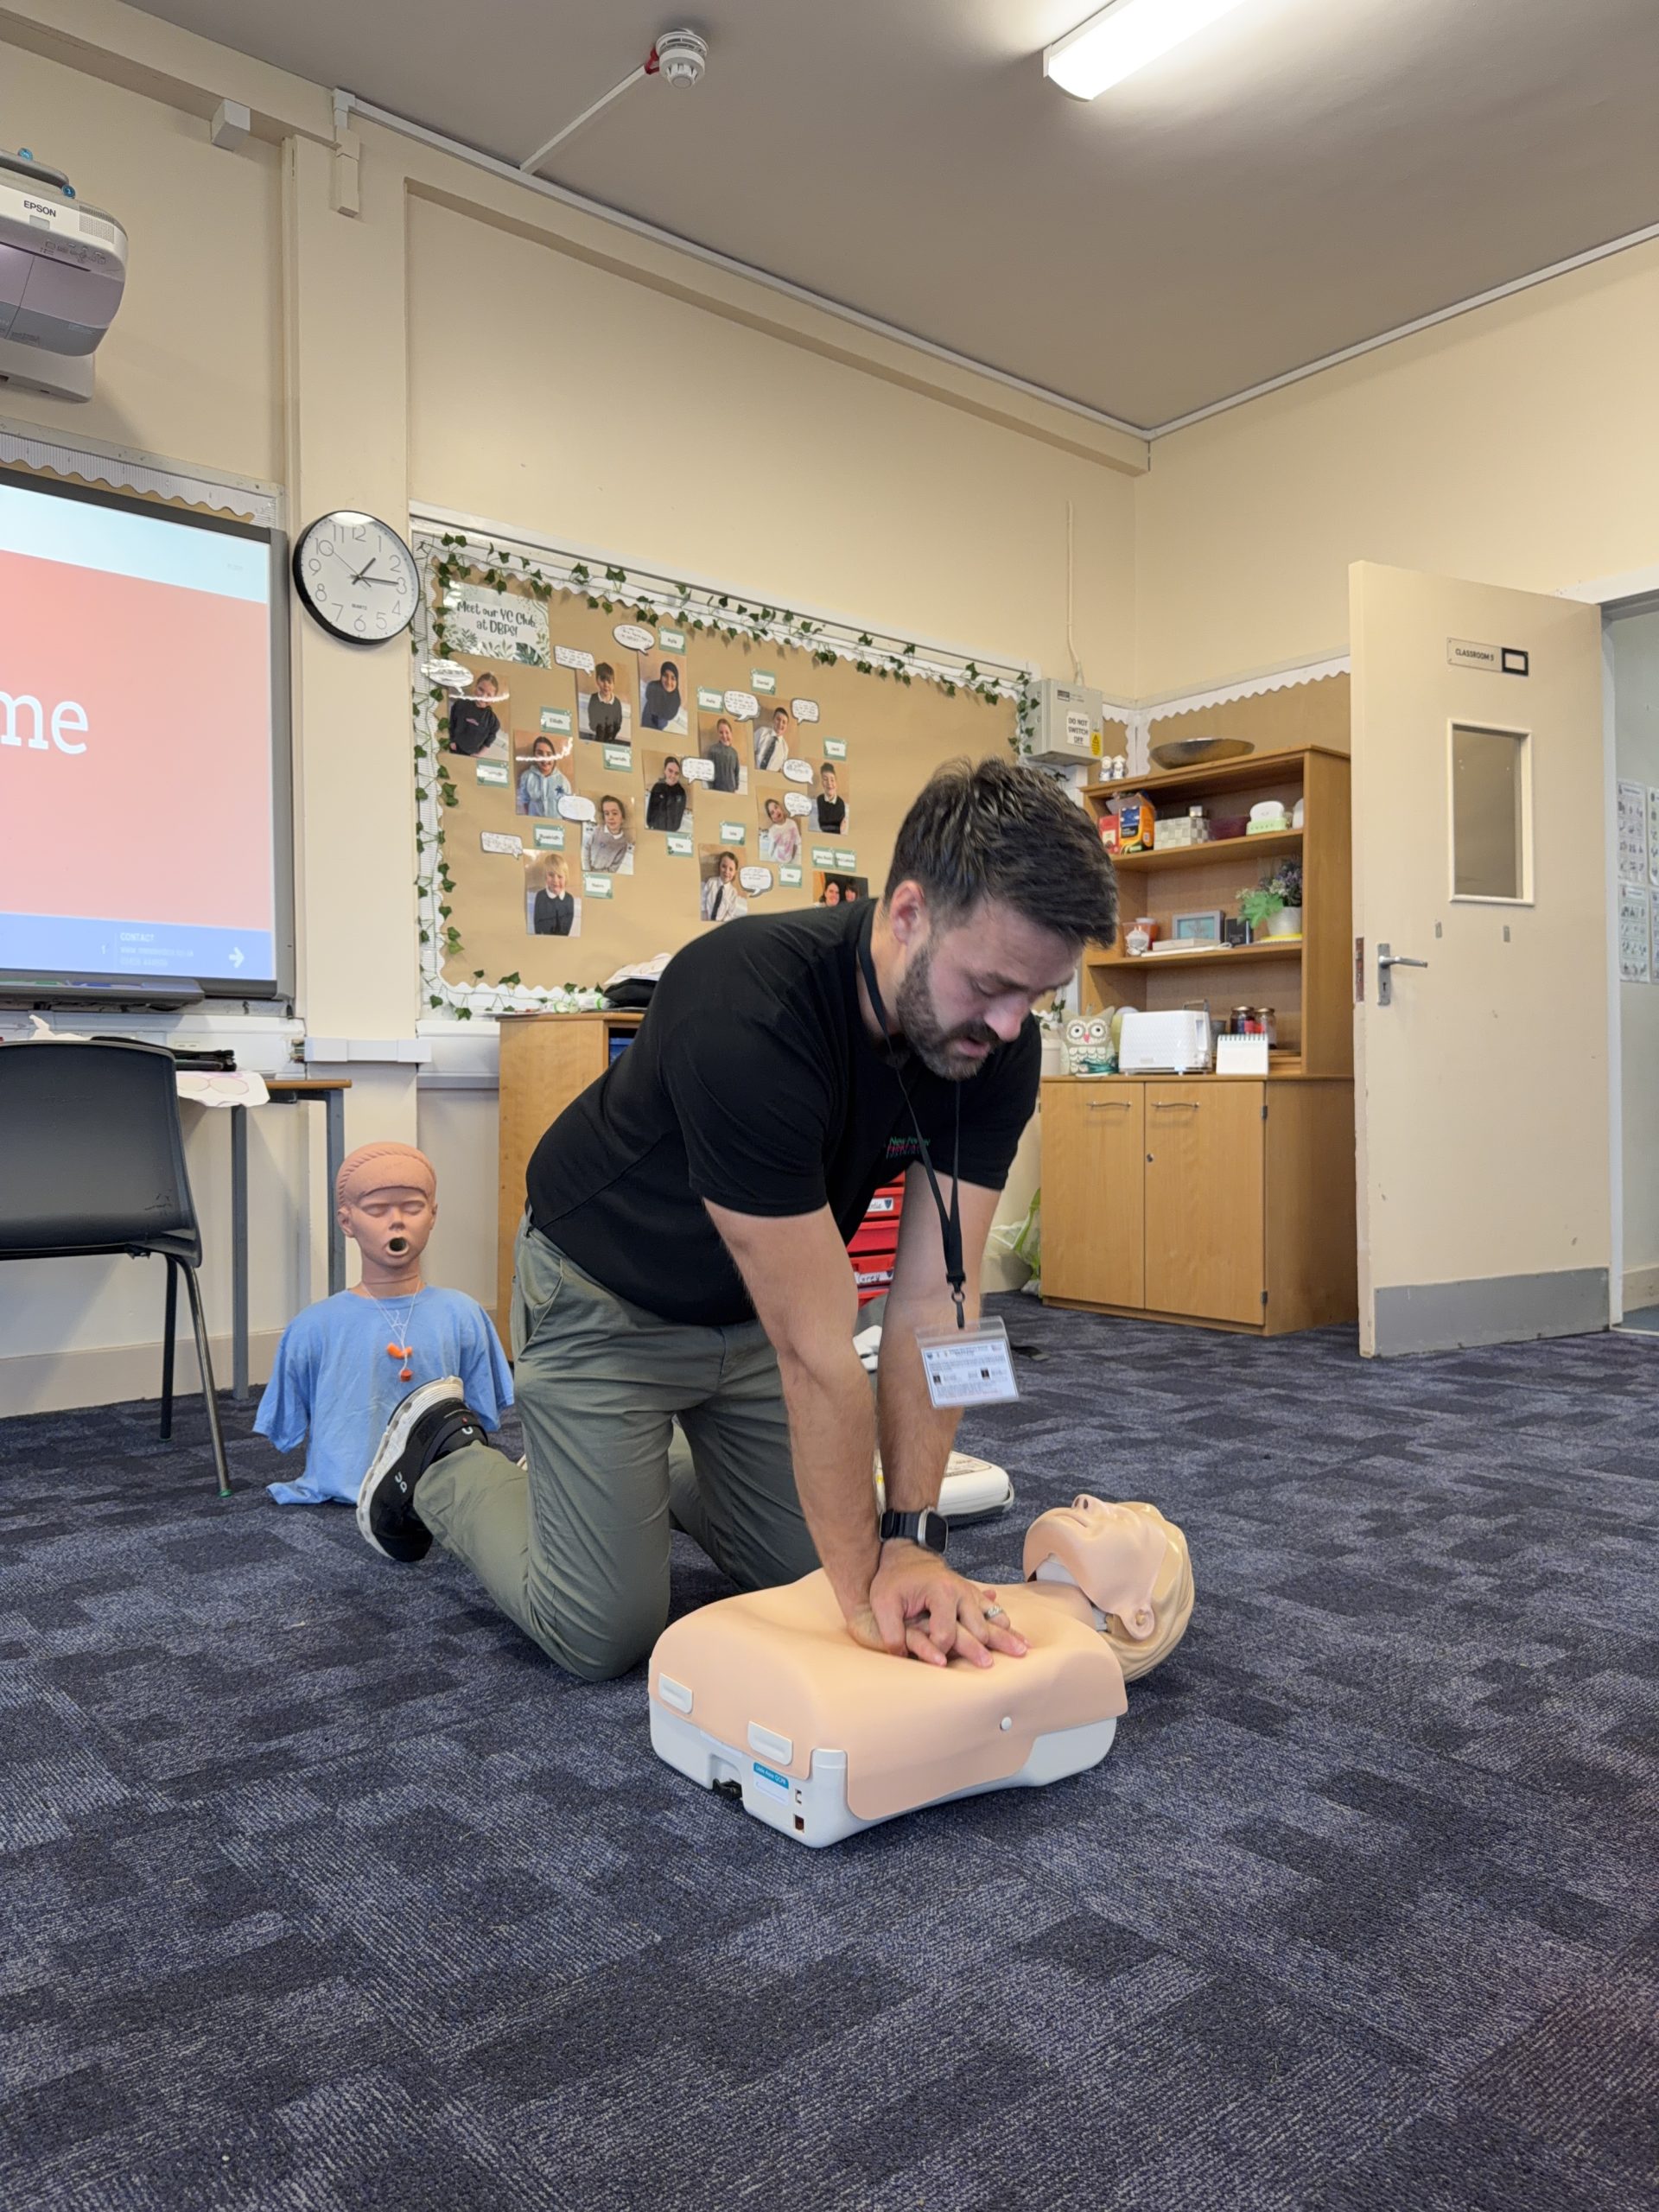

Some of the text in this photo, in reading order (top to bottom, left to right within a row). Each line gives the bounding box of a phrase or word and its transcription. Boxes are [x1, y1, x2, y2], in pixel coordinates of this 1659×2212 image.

[23, 200, 56, 218] EPSON
[333, 524, 345, 543] 11
[352, 524, 366, 542] 12
[315, 537, 334, 556] 10
[308, 558, 321, 576] 9
[389, 554, 401, 573] 2
[315, 583, 327, 602] 8
[396, 576, 407, 594] 3
[331, 602, 344, 622] 7
[391, 600, 401, 615] 4
[456, 601, 536, 628] Meet our YC Club
[353, 614, 366, 632] 6
[376, 611, 388, 630] 5
[476, 619, 518, 638] at DBPS!
[1455, 648, 1489, 660] CLASSROOM
[1068, 727, 1089, 735] SWITCH
[119, 932, 155, 943] CONTACT
